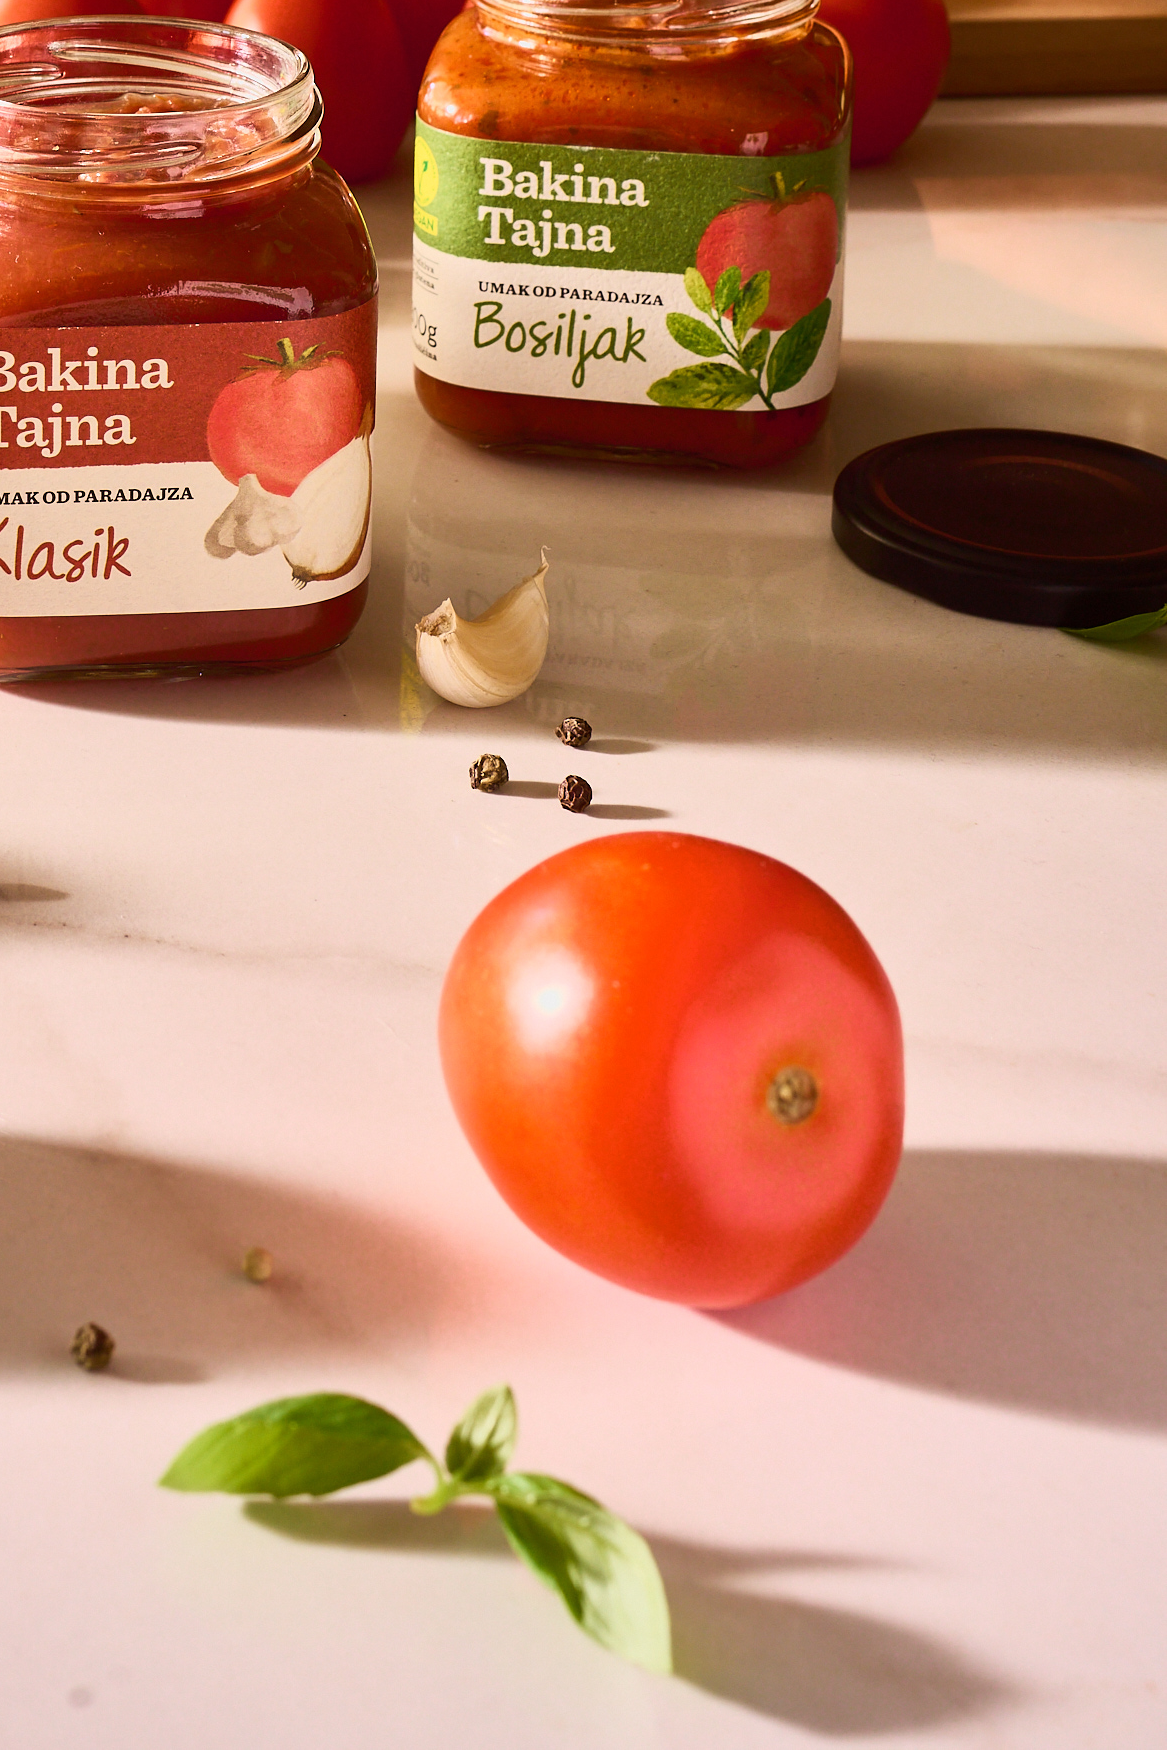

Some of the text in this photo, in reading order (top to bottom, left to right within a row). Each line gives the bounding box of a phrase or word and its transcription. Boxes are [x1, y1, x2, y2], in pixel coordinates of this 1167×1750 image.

[479, 158, 649, 207] Bakina
[478, 206, 615, 257] Tajna
[478, 281, 664, 306] UMAK OD PARADAJZA
[474, 301, 646, 389] Bosiljak
[42, 490, 70, 504] OD
[73, 487, 194, 504] PARADAJZA
